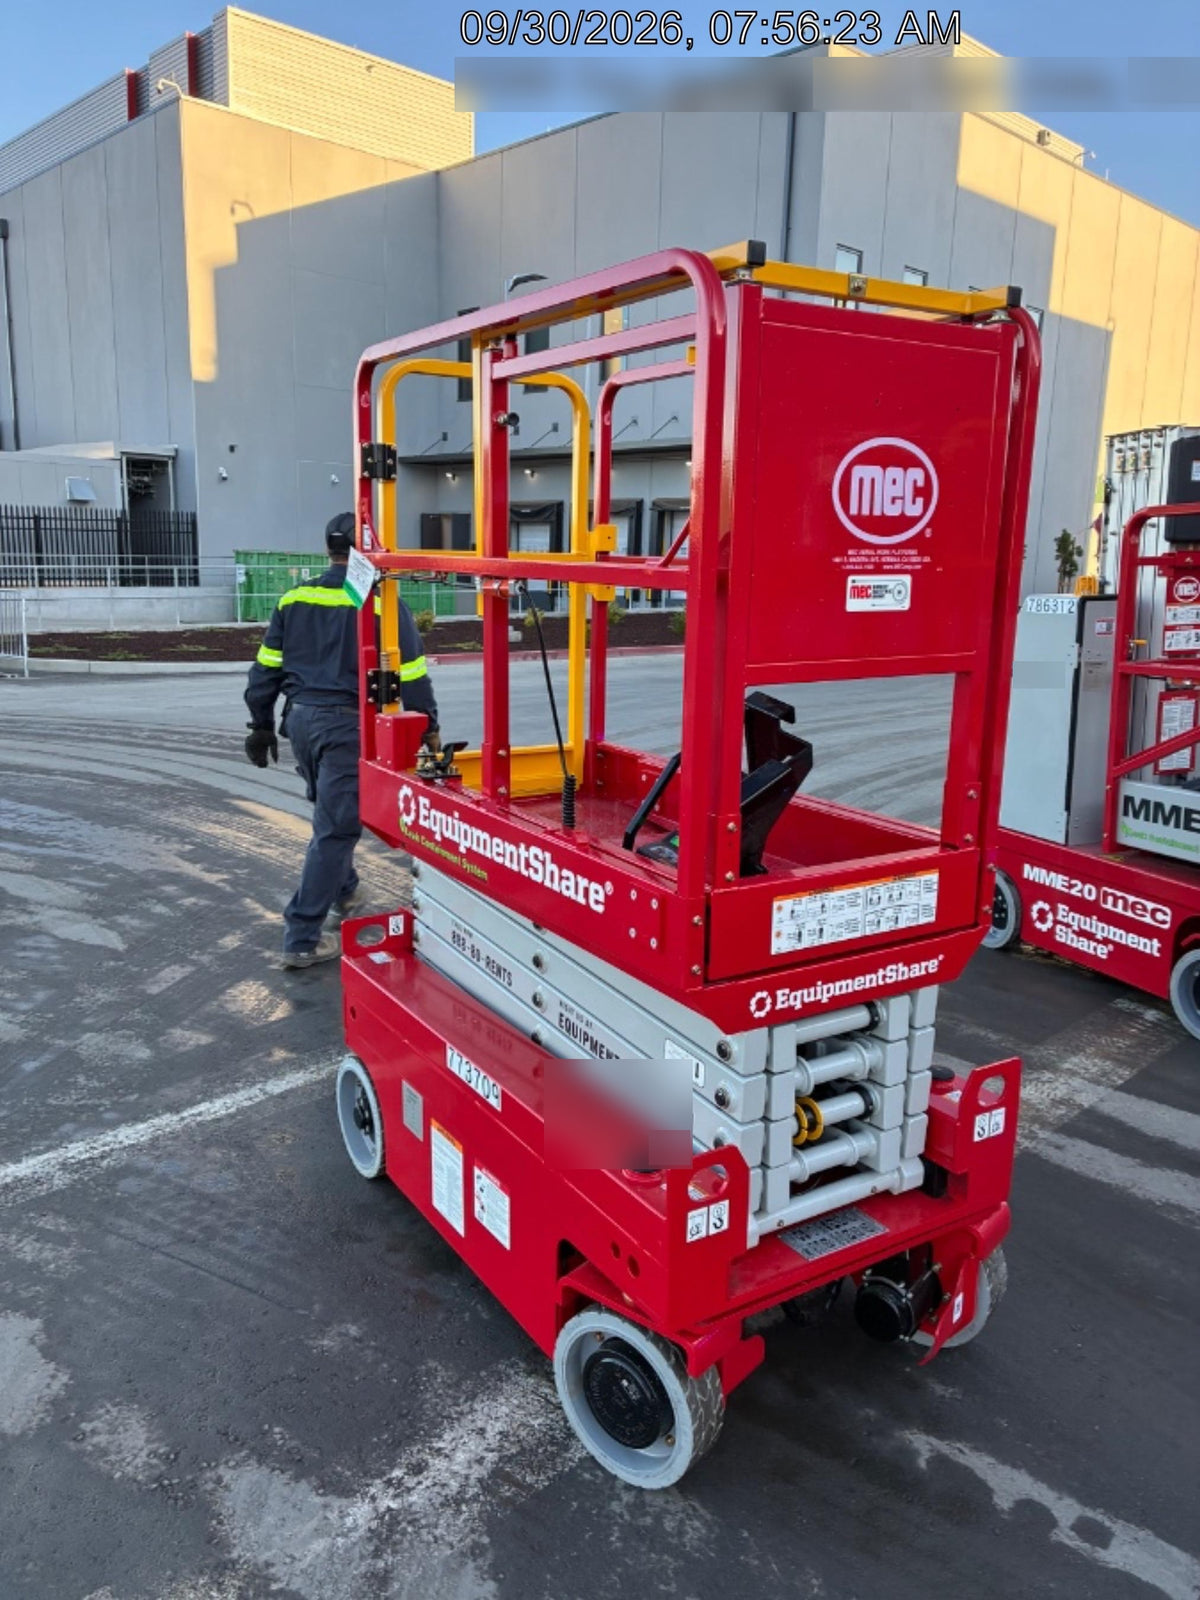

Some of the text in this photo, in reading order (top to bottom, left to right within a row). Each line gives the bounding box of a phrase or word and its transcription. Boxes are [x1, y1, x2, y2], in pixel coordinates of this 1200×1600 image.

[1027, 598, 1076, 614] 786312
[417, 795, 606, 914] EquipmentShare
[1023, 863, 1097, 901] MME20
[1055, 902, 1162, 958] Equipment
[1055, 924, 1110, 960] Share
[774, 957, 940, 1011] EquipmentShare
